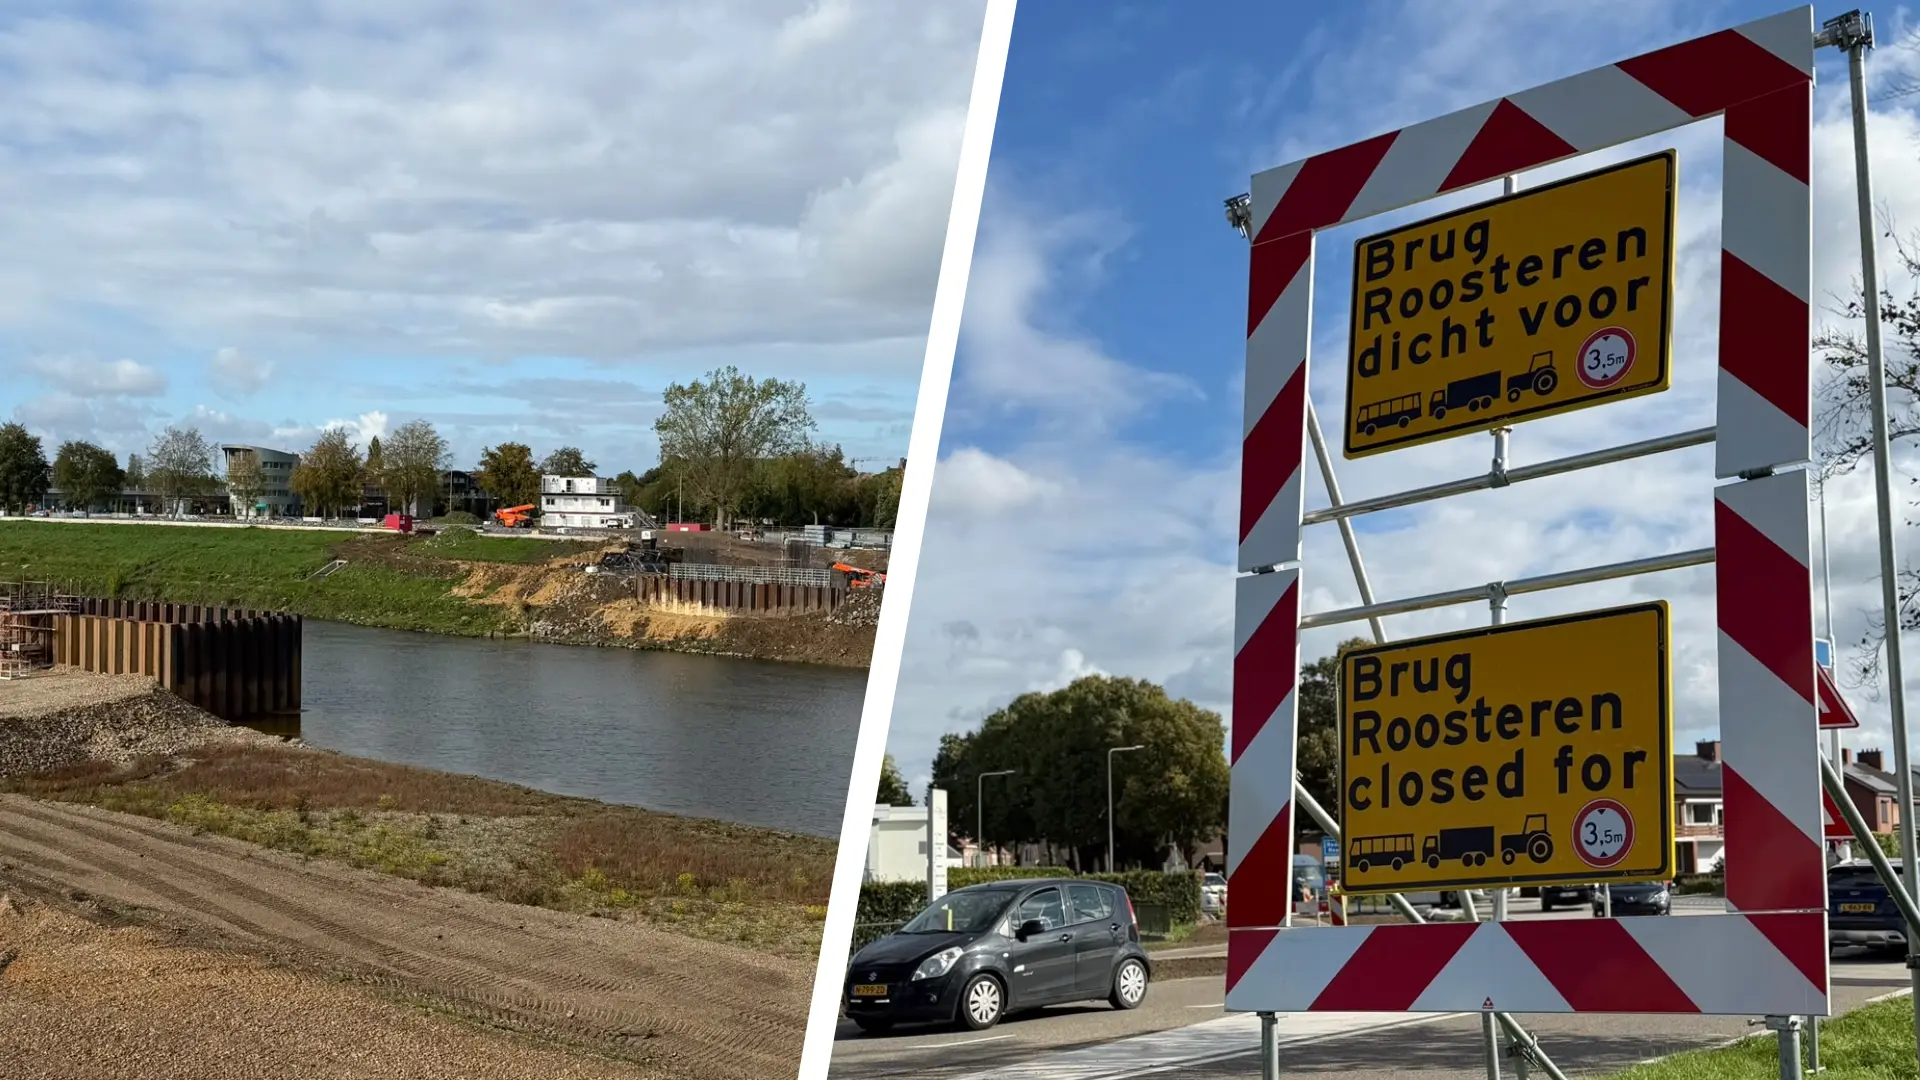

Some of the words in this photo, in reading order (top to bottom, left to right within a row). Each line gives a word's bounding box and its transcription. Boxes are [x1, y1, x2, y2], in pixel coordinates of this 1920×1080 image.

[1363, 226, 1647, 331] Roosteren
[1365, 218, 1491, 283] Brug
[1357, 307, 1495, 379] dicht
[1518, 276, 1650, 337] voor
[1353, 652, 1472, 704] Brug
[1352, 692, 1623, 756] Roosteren
[1348, 748, 1525, 811] closed
[1553, 745, 1648, 794] for
[1584, 821, 1623, 846] 3,5m
